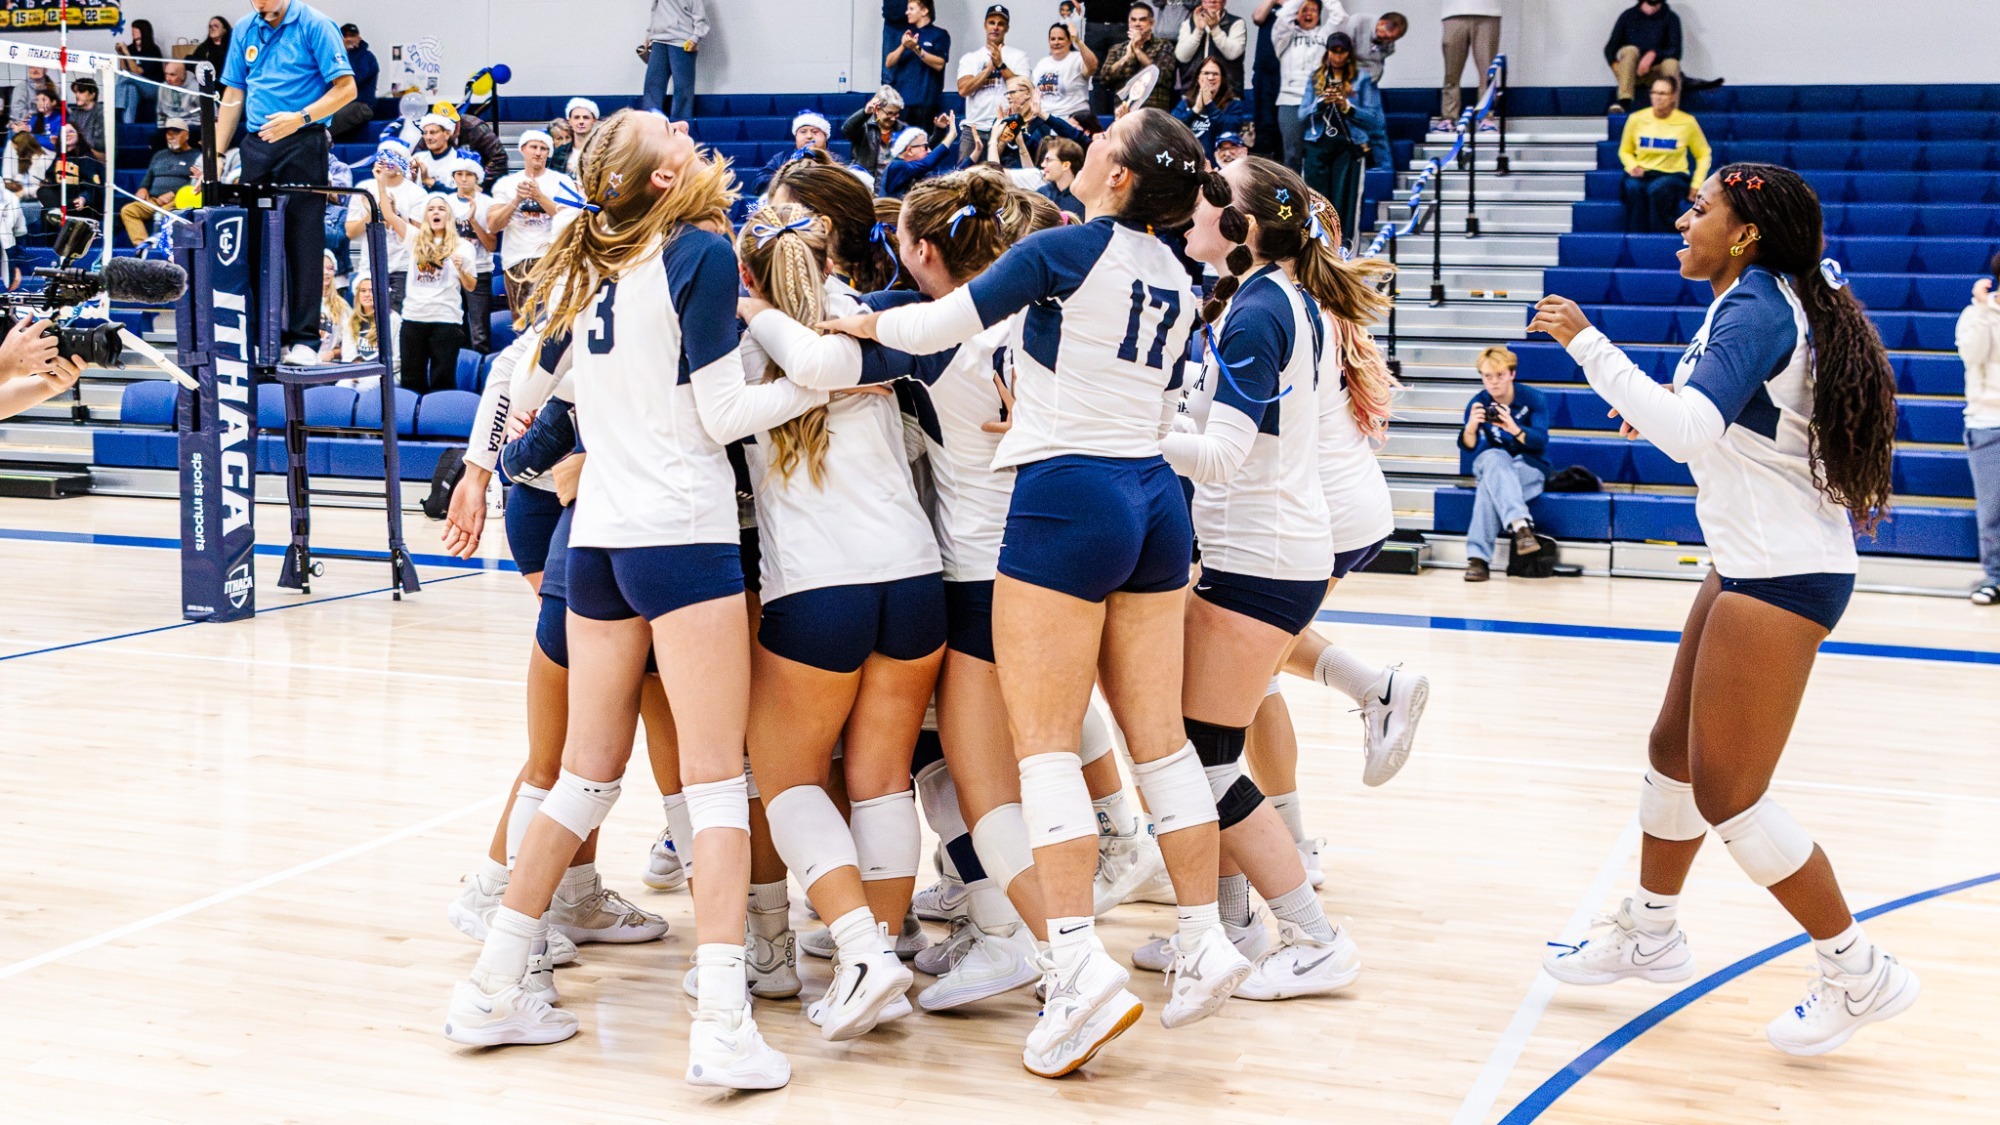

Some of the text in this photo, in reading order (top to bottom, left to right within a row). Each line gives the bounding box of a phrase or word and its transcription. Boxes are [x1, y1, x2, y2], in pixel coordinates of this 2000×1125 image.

[15, 11, 27, 24] 15
[47, 10, 58, 22] 12
[85, 9, 98, 22] 22
[28, 47, 51, 59] ITHACA
[406, 44, 441, 74] SENIOR
[587, 277, 618, 355] 3
[1116, 278, 1181, 370] 17
[212, 288, 251, 538] ITHACA
[488, 394, 511, 452] ITHACA
[191, 452, 206, 552] sports imports
[224, 575, 254, 595] ITHACA
